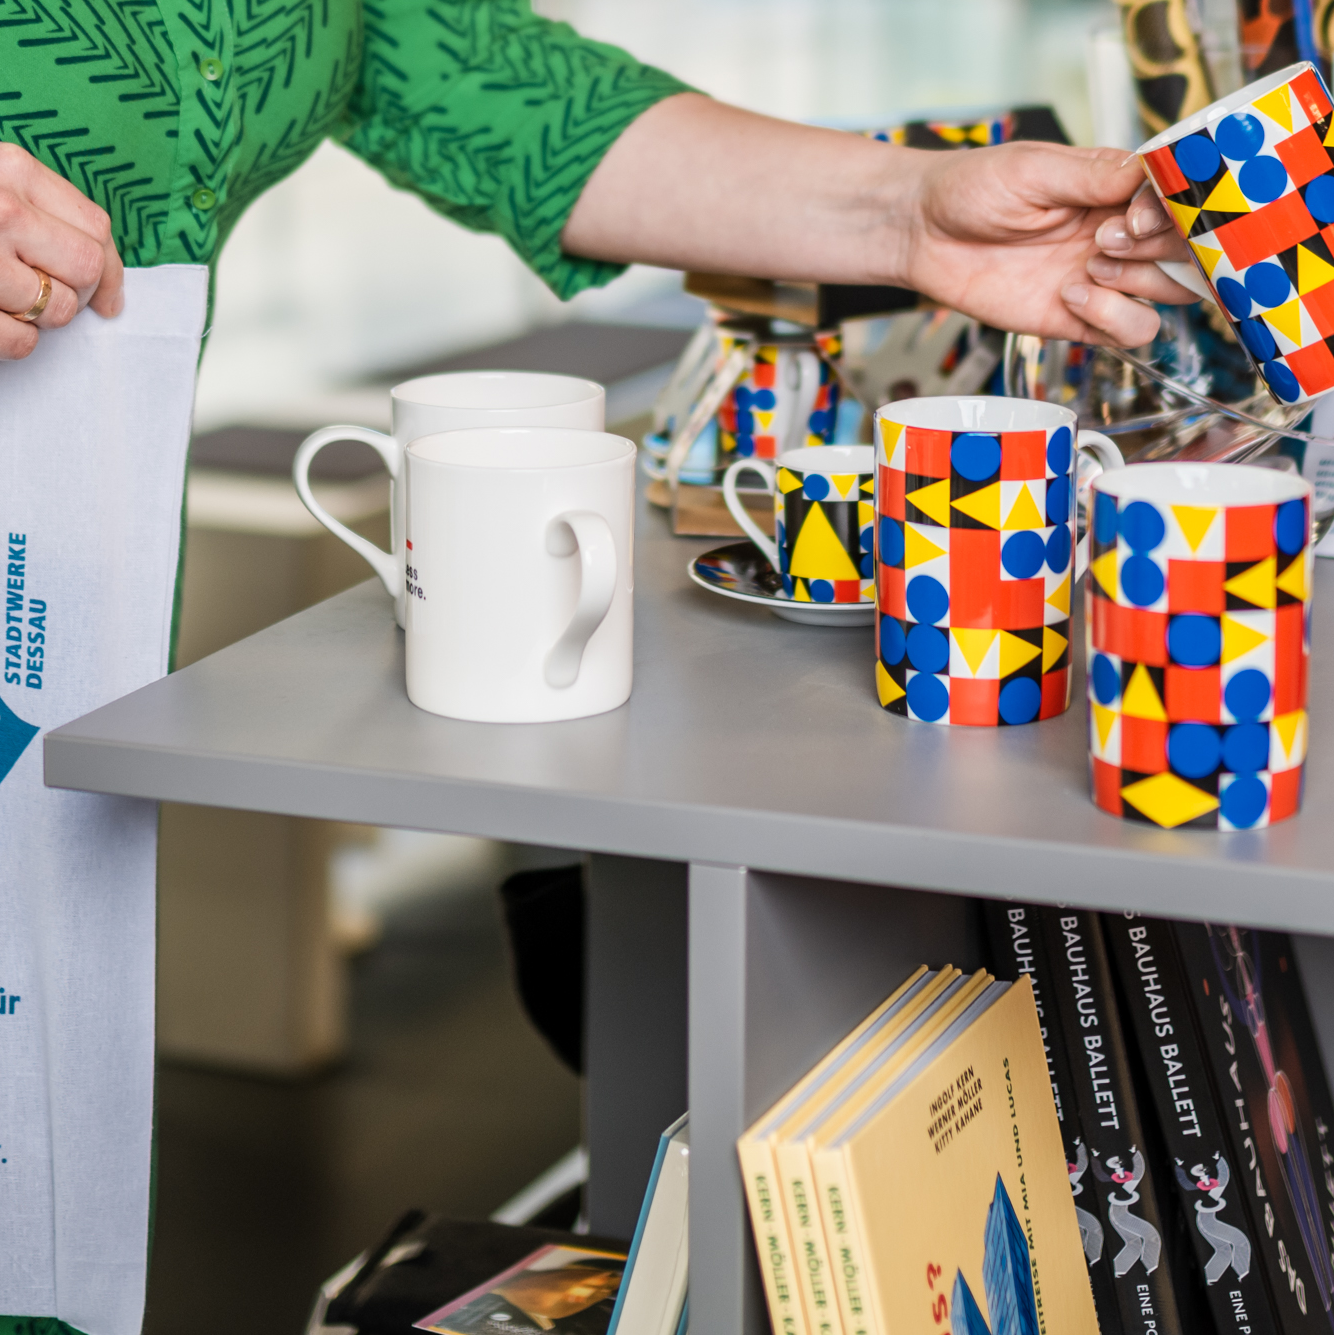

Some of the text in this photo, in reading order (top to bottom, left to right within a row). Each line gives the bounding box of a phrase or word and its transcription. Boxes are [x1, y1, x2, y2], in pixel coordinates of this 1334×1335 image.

[4, 533, 31, 686] STADTWERKE
[405, 564, 418, 581] ess
[26, 599, 46, 689] DESSAU
[1061, 917, 1119, 1129] BAUHAUS BALLETT
[1129, 927, 1173, 1037] BAUHAUS
[1161, 1044, 1201, 1136] BALLETT
[926, 1077, 983, 1141] WERNER MÖLLER
[928, 1065, 975, 1118] INGOLF KERN
[933, 1097, 984, 1155] KITTY KAHANE
[1219, 994, 1275, 1238] BAUHAUS
[757, 1175, 775, 1223] KERN
[769, 1235, 791, 1304] MÖLLER
[794, 1181, 812, 1228] KERN
[806, 1241, 828, 1310] MÖLLER
[829, 1187, 848, 1234] KERN
[842, 1248, 863, 1312] MÖLLER
[1002, 1057, 1047, 1335] EITREISE MIT MIA UND LUCAS
[1137, 1285, 1153, 1315] EINE
[1230, 1291, 1247, 1321] EINE
